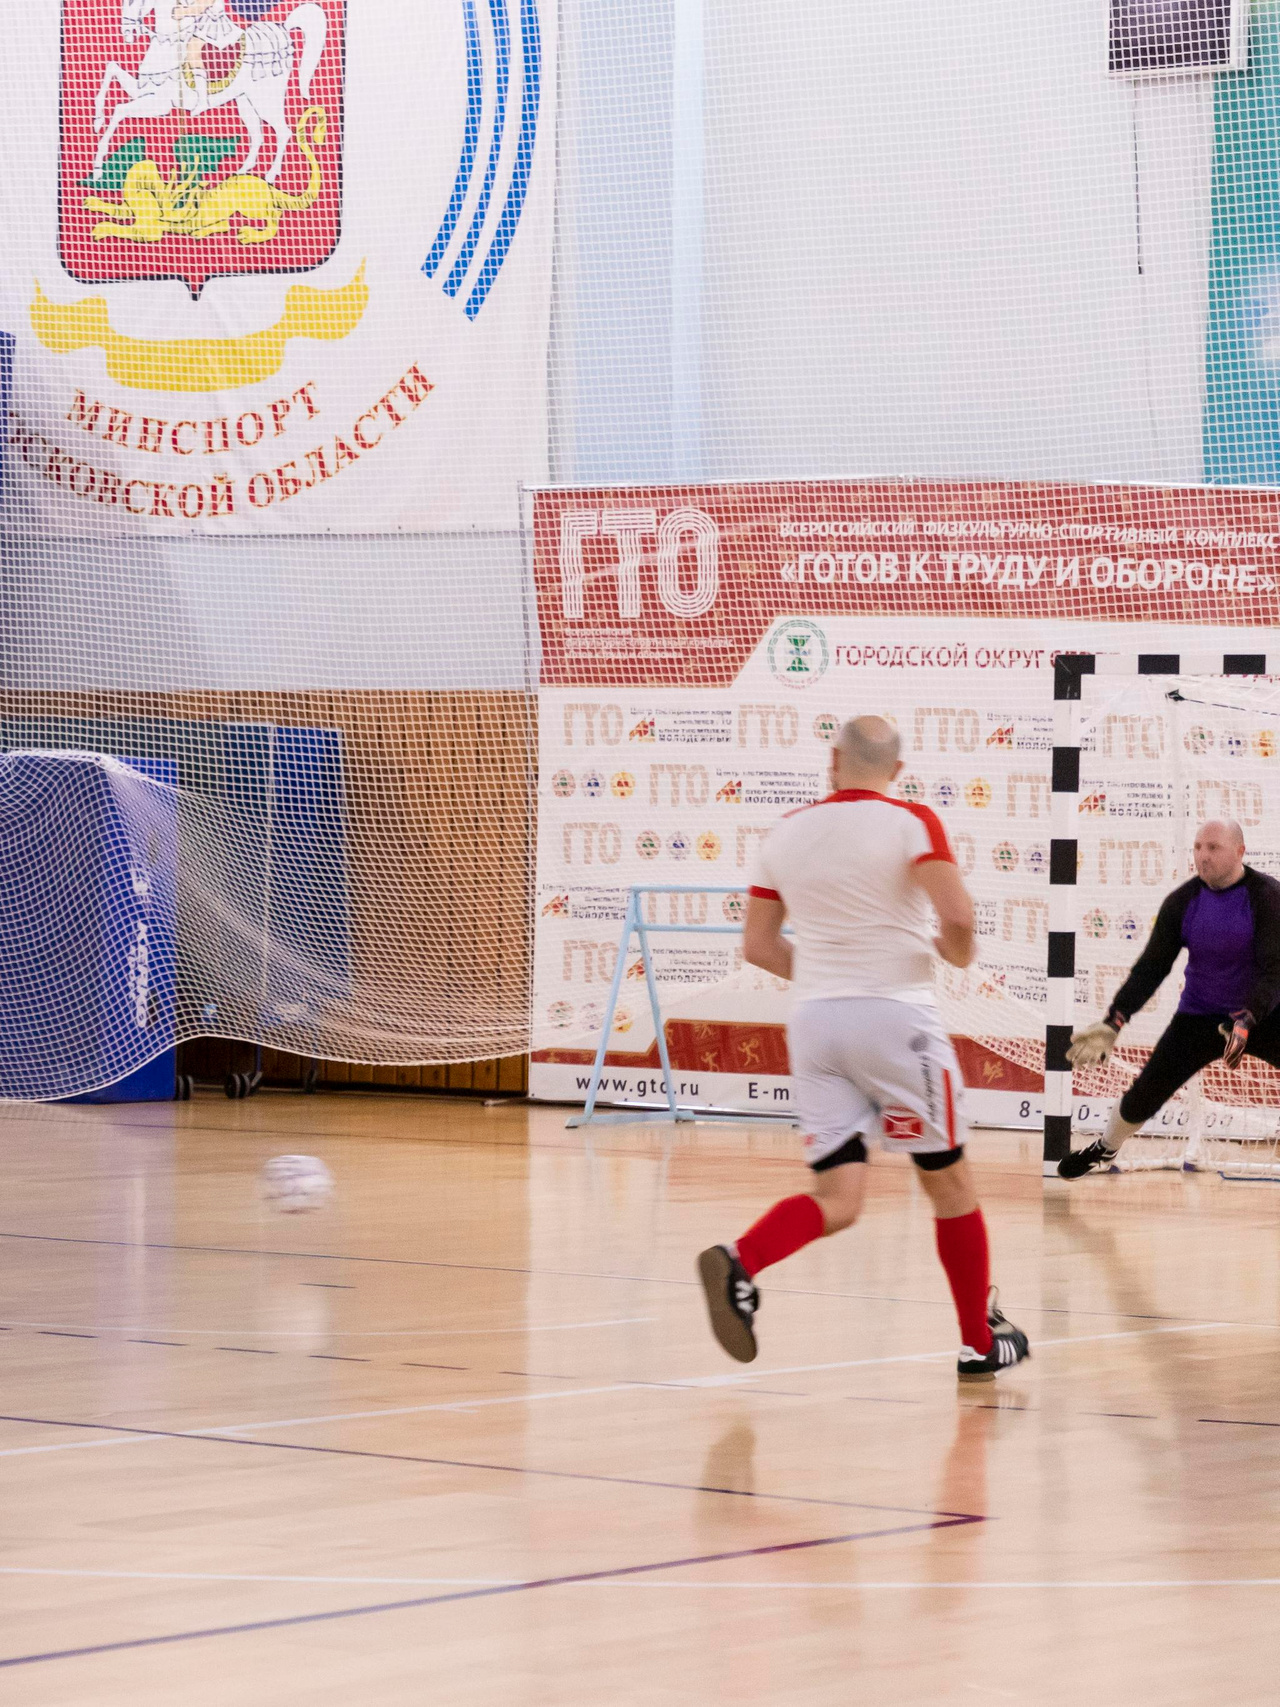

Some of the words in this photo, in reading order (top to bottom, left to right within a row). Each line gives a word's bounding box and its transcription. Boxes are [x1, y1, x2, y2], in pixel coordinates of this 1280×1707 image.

[66, 380, 320, 455] МИНСПОРТ
[248, 361, 435, 508] ОБЛАСТИ
[780, 516, 916, 537] ВСЕРОССИЙСКИЙ
[923, 521, 1178, 544] ФИЗКУЛЬТУРНО-СПОРТИВНЫЙ
[1185, 529, 1280, 549] КОМПЛЕКС
[559, 508, 720, 619] ГТО
[781, 552, 899, 584] «ГОТОВ
[909, 552, 930, 583] К
[939, 553, 1048, 591] ТРУДУ
[1055, 556, 1080, 587] И
[1090, 557, 1275, 593] ОБОРОНЕ»
[835, 642, 968, 669] ГОРОДСКОЙ
[975, 647, 1045, 669] ОКРУГ
[564, 703, 624, 746] ГТО
[738, 704, 800, 748] ГТО
[914, 707, 980, 753] ГТО
[649, 764, 710, 807] ГТО
[563, 822, 622, 865] ГТО
